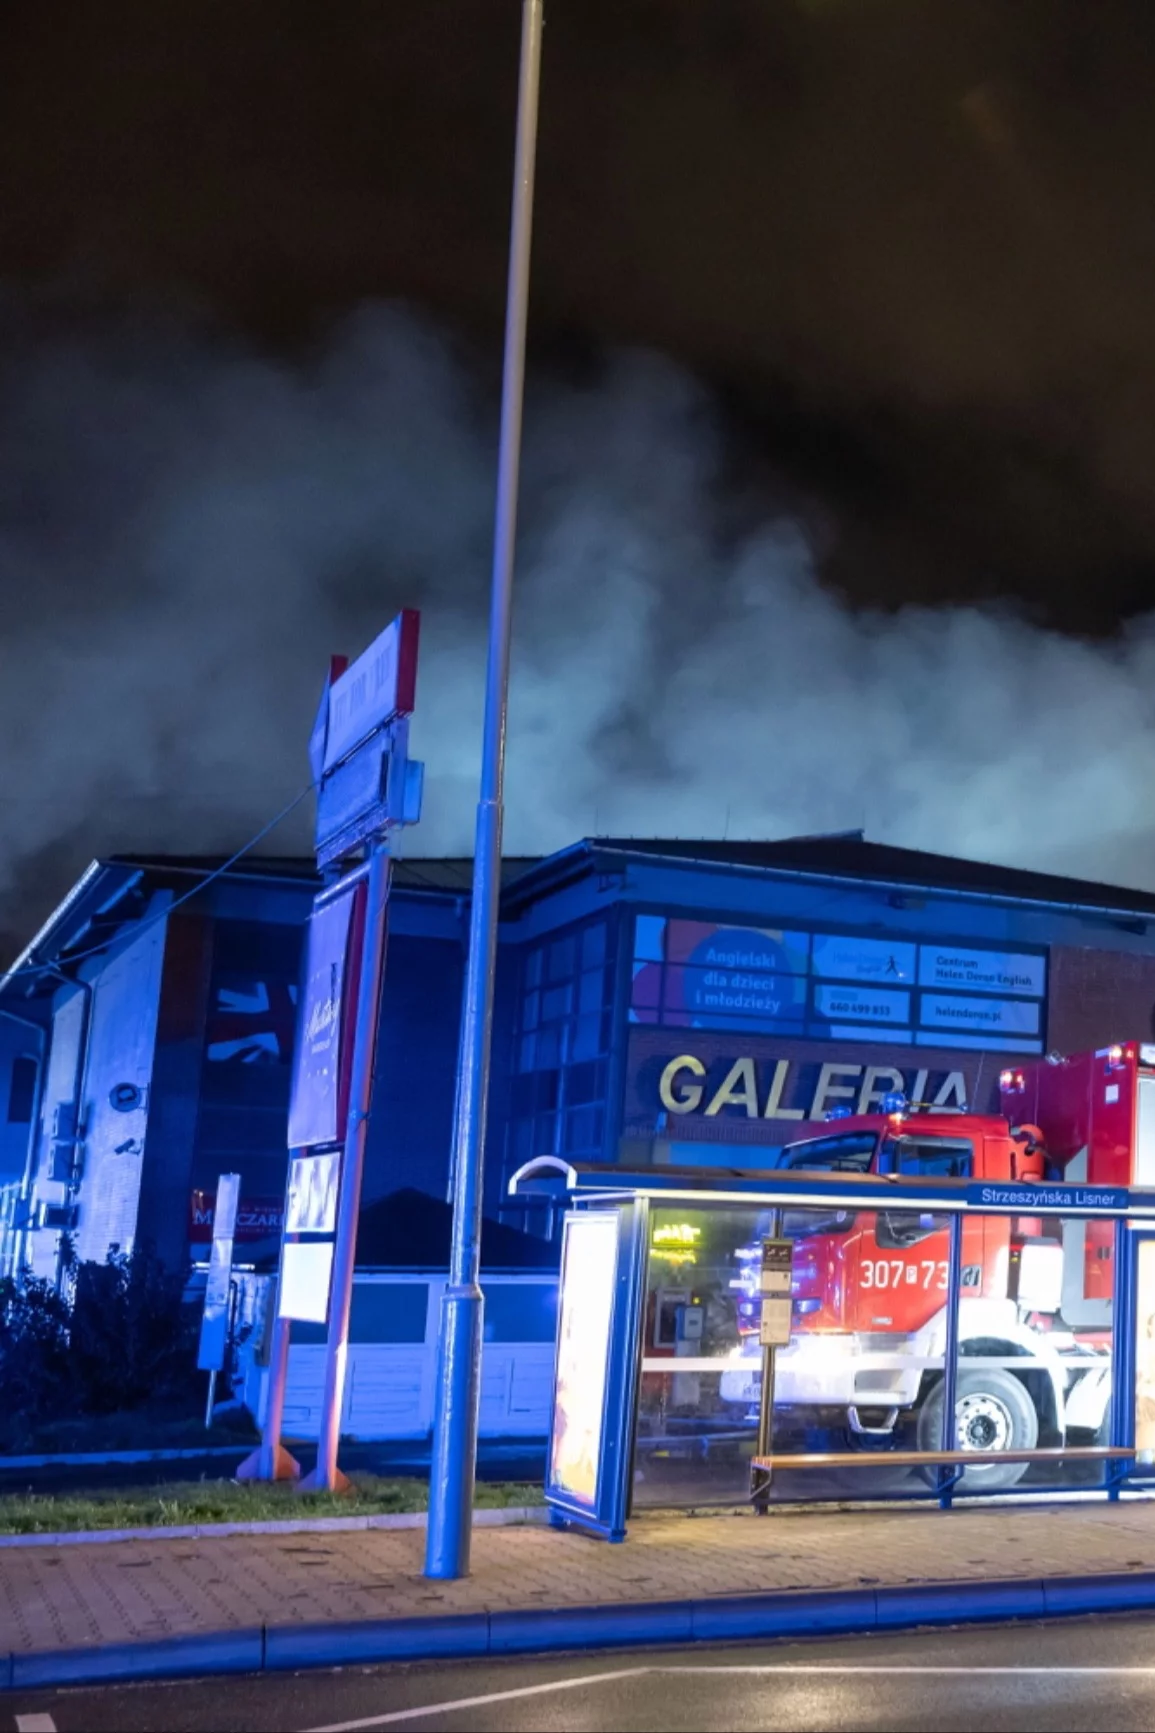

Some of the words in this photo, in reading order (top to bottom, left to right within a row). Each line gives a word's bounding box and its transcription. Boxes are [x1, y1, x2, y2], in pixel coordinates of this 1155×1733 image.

[705, 947, 776, 969] Angielski
[703, 971, 727, 987] dla
[731, 972, 774, 991] dzieci
[659, 1054, 968, 1121] GALERIA
[982, 1188, 1071, 1206] Strzeszyńska
[1076, 1191, 1116, 1205] Lisner
